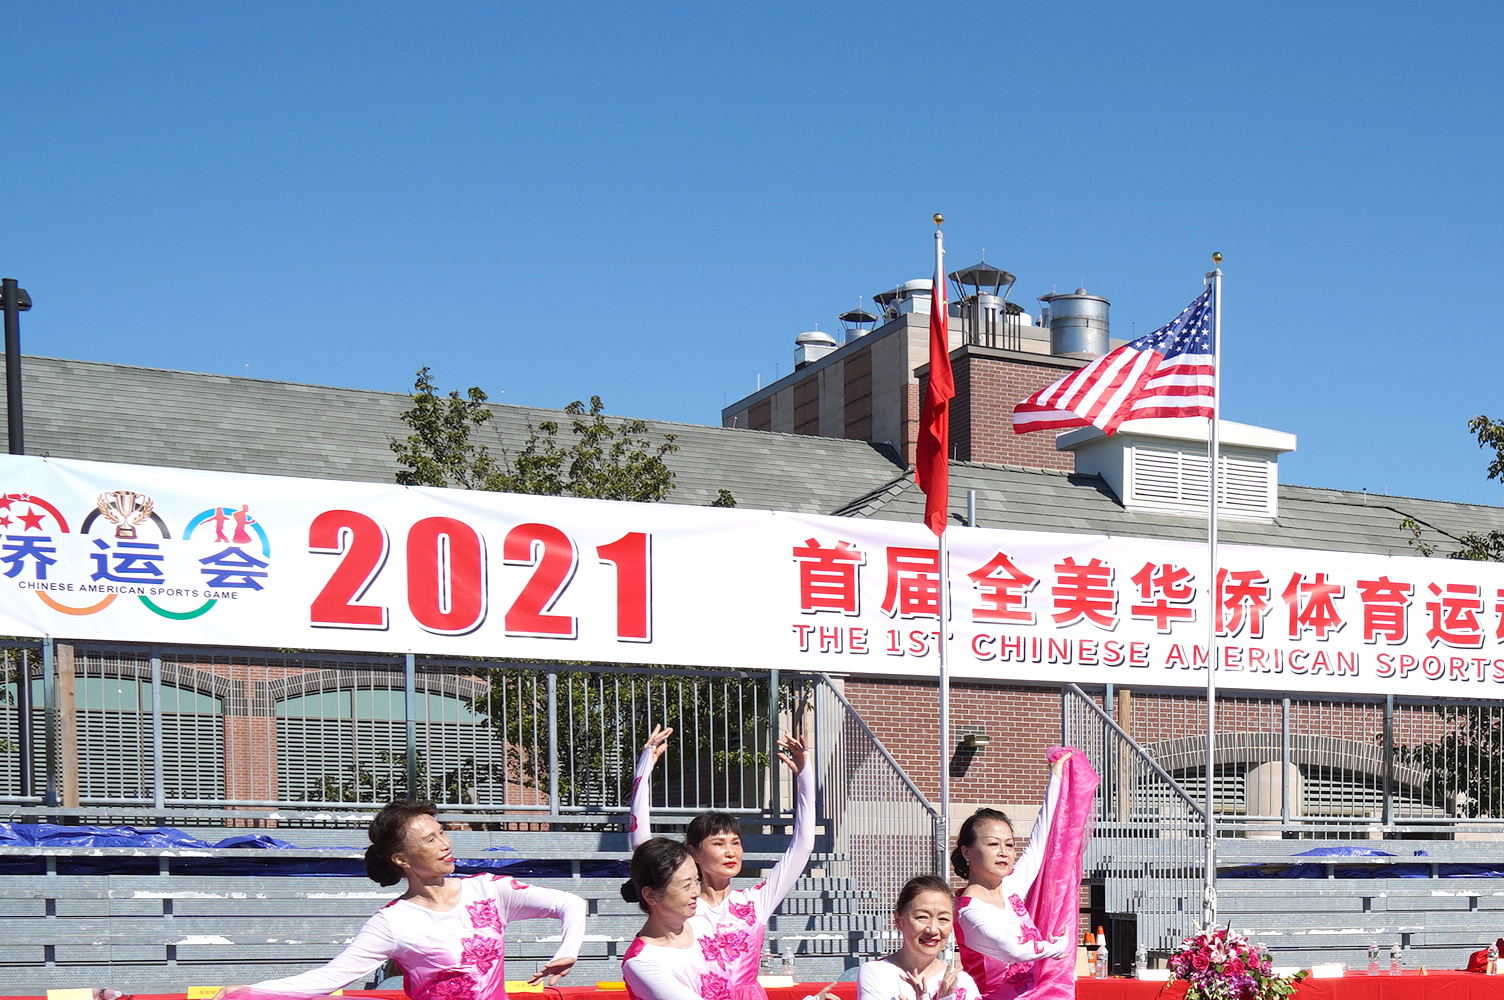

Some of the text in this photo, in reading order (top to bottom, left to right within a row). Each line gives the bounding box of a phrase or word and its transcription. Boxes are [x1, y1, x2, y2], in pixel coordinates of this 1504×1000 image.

[18, 580, 239, 600] CHINESE AMERICAN SPORTS GAME
[308, 508, 652, 643] 2021
[792, 624, 869, 655] THE
[971, 633, 1150, 668] CHINESE
[1164, 643, 1360, 676] AMERICAN
